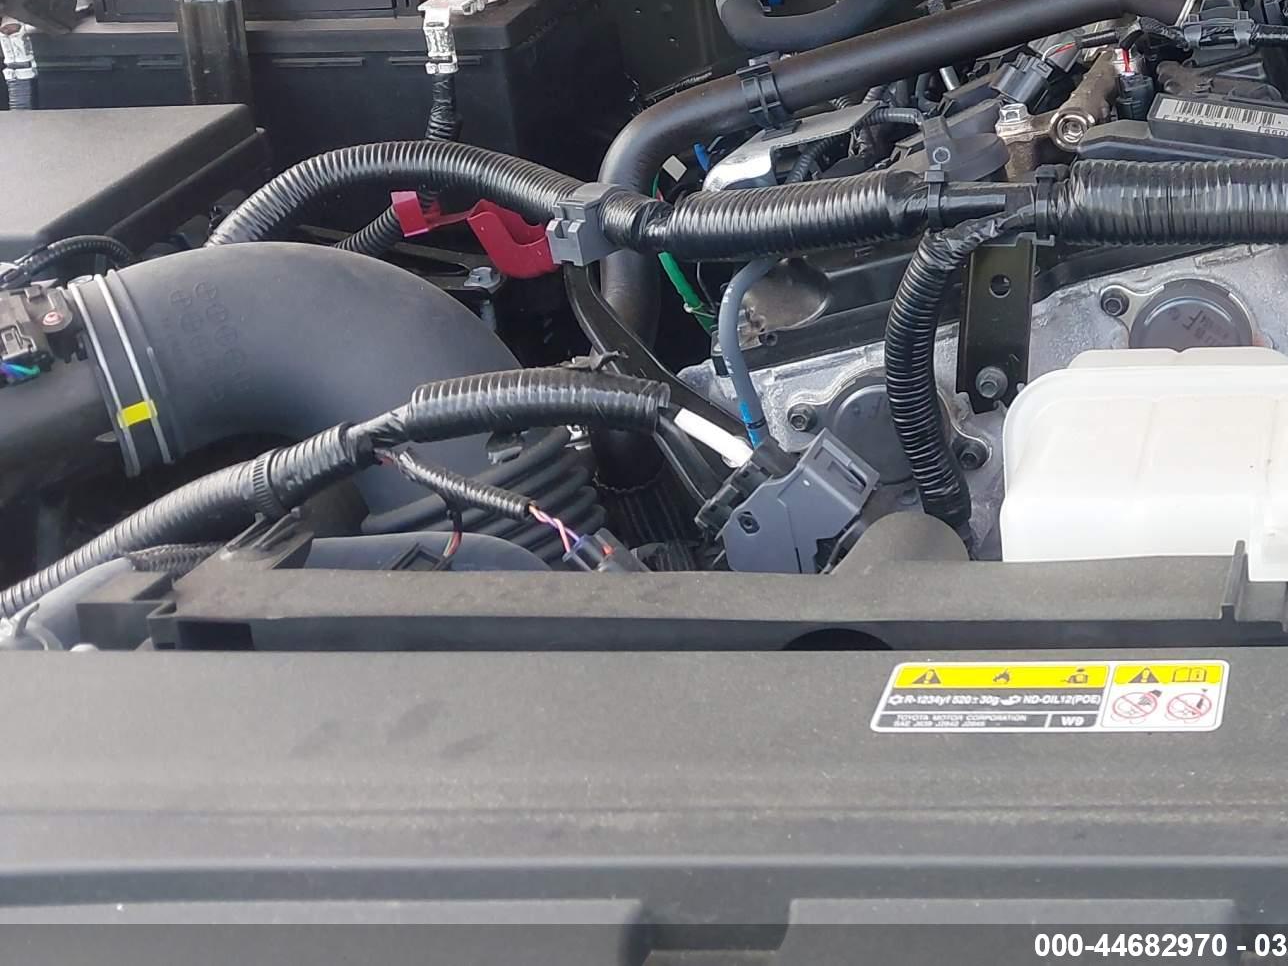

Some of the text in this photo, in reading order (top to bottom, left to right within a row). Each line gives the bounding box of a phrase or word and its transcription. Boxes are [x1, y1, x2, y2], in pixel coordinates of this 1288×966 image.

[903, 694, 952, 707] R-1234yf
[1022, 694, 1101, 706] ND-OIL12(POE)
[1060, 715, 1085, 727] W9
